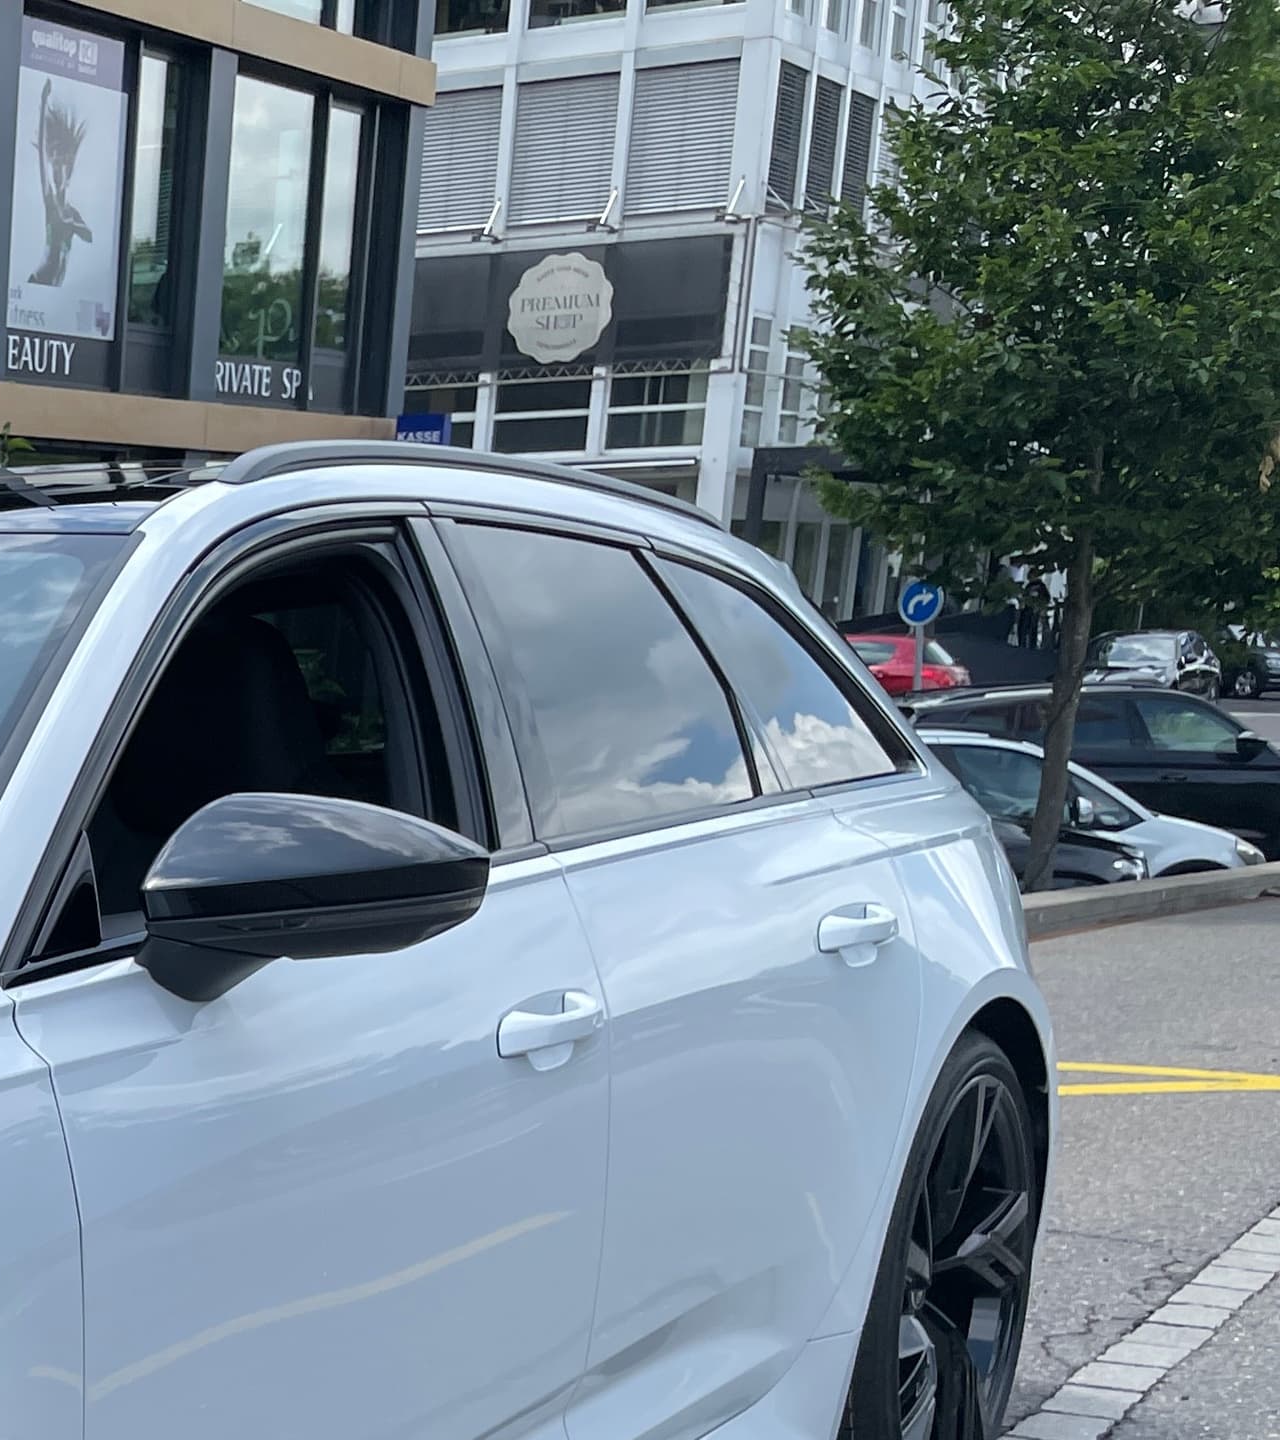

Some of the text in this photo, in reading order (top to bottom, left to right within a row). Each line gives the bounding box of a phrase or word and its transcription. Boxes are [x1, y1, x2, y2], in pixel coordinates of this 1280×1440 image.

[520, 293, 601, 313] PREMIUM
[7, 335, 76, 376] EAUTY
[281, 367, 313, 400] SP
[397, 430, 441, 443] KASSE
